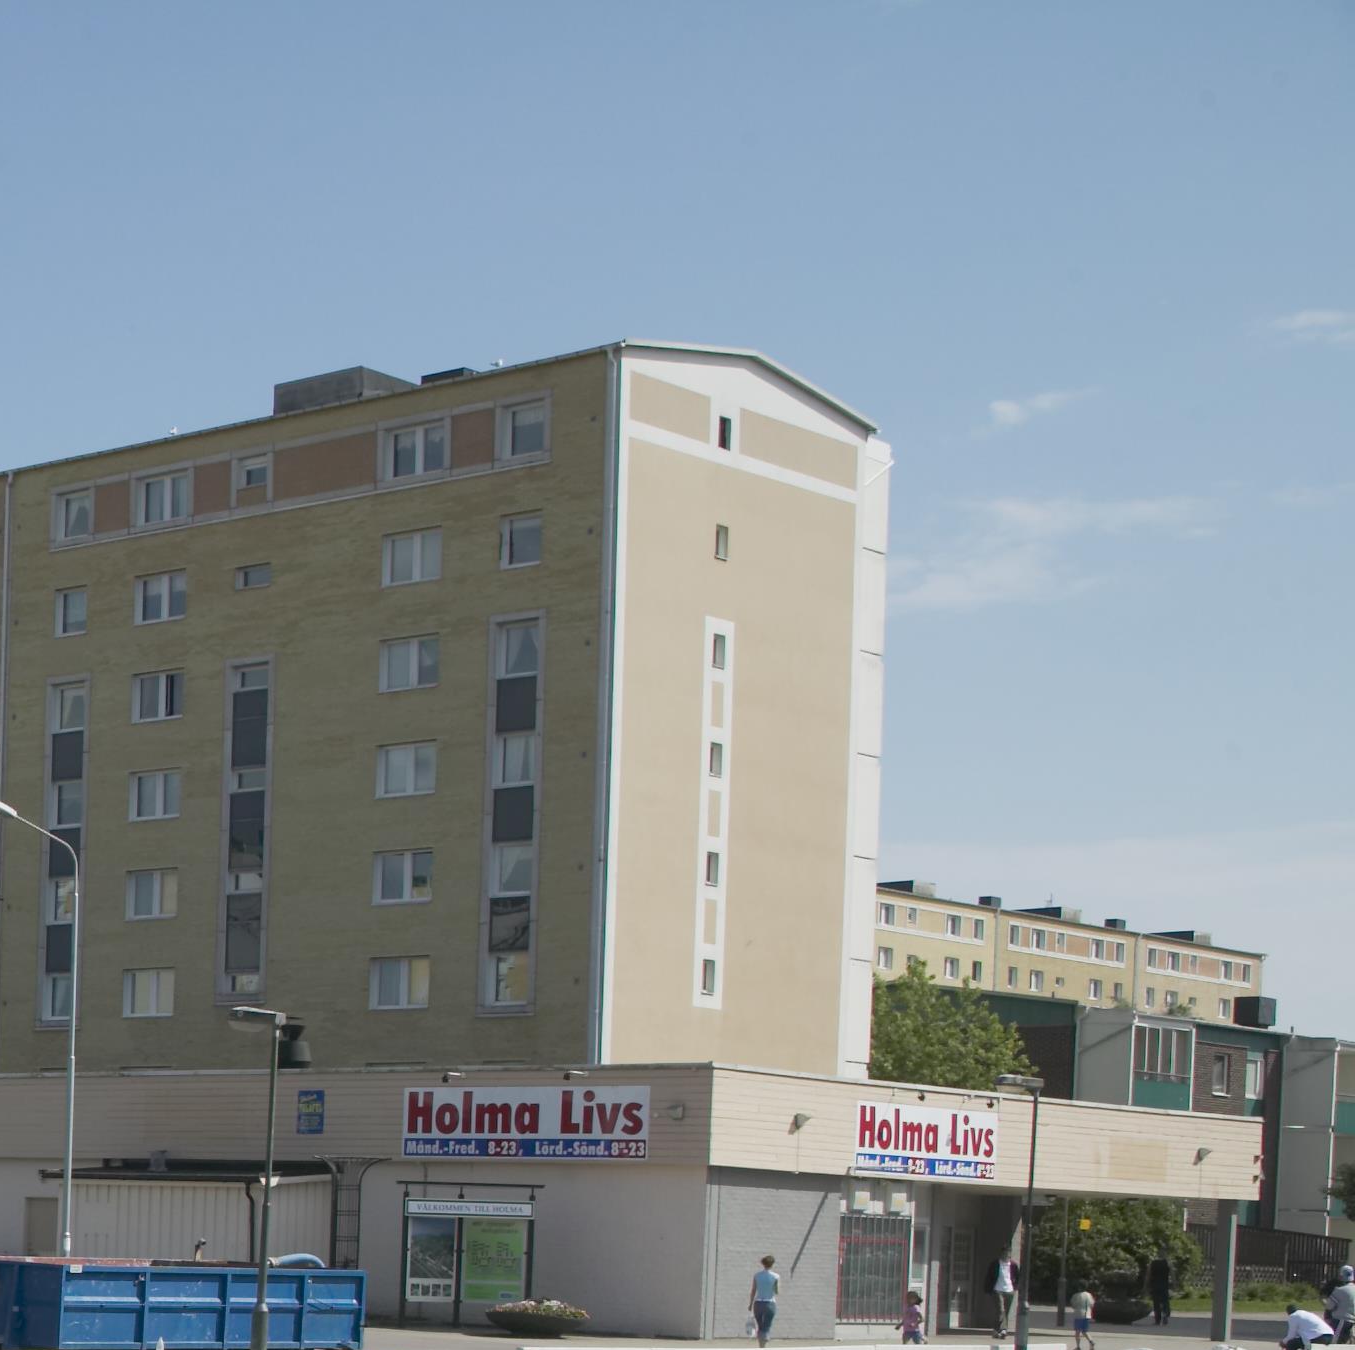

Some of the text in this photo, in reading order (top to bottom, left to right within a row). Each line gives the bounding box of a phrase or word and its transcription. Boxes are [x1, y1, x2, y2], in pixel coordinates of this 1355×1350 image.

[407, 1090, 644, 1135] Holma Livs
[858, 1105, 994, 1158] Holma Livs
[406, 1140, 479, 1155] Månd.-Fred.
[535, 1141, 608, 1156] Lörd.-Sönd.
[417, 1203, 523, 1213] VÄLKOMMEN TILL HOLMA
